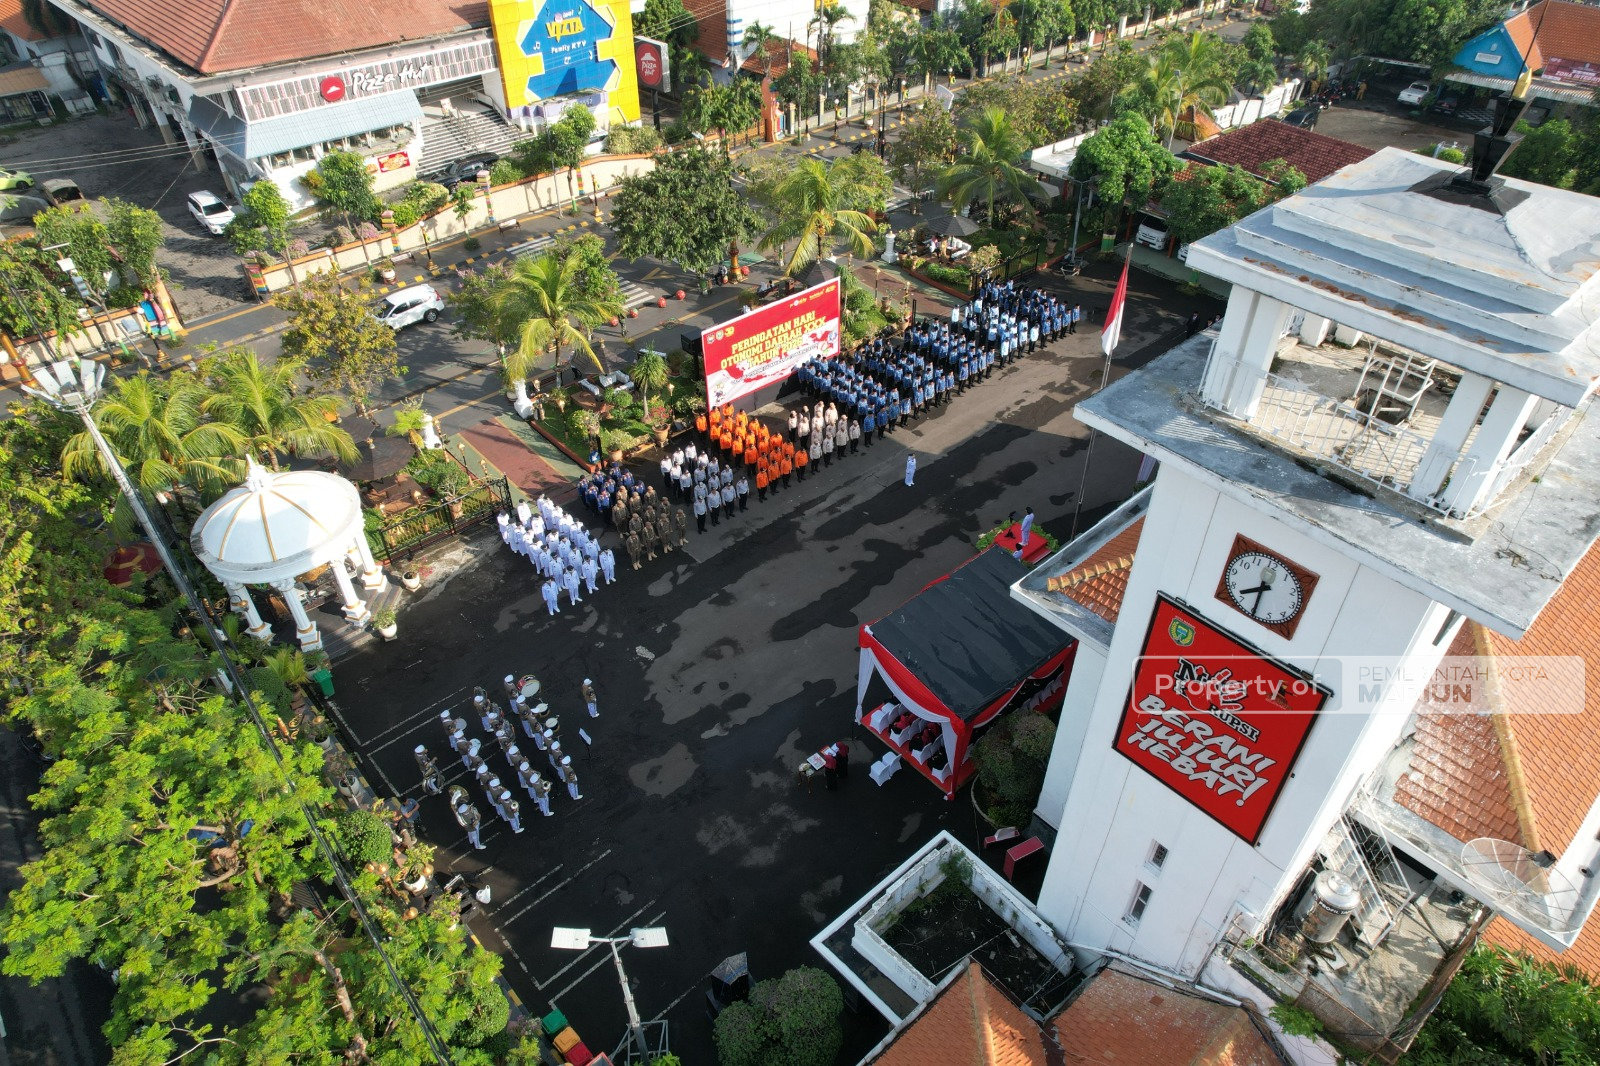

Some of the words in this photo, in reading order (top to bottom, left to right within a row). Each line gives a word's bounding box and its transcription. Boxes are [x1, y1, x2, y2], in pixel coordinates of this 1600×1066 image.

[572, 40, 586, 49] KTV
[642, 61, 656, 71] Pizza
[352, 72, 396, 96] Pizza
[399, 62, 433, 83] Hut
[732, 320, 793, 354] PERINGATAN
[794, 310, 815, 328] HARI
[721, 343, 763, 369] OTONOMI
[765, 326, 802, 350] DAERAH
[804, 316, 826, 333] XXX
[1239, 560, 1250, 570] 10
[1252, 556, 1262, 566] 11
[1267, 560, 1278, 572] 12
[1284, 574, 1288, 582] 1
[1231, 581, 1236, 589] 8
[1290, 588, 1296, 596] 2
[1289, 601, 1295, 609] 3
[1266, 612, 1272, 620] 5
[1139, 694, 1276, 772] BERANI
